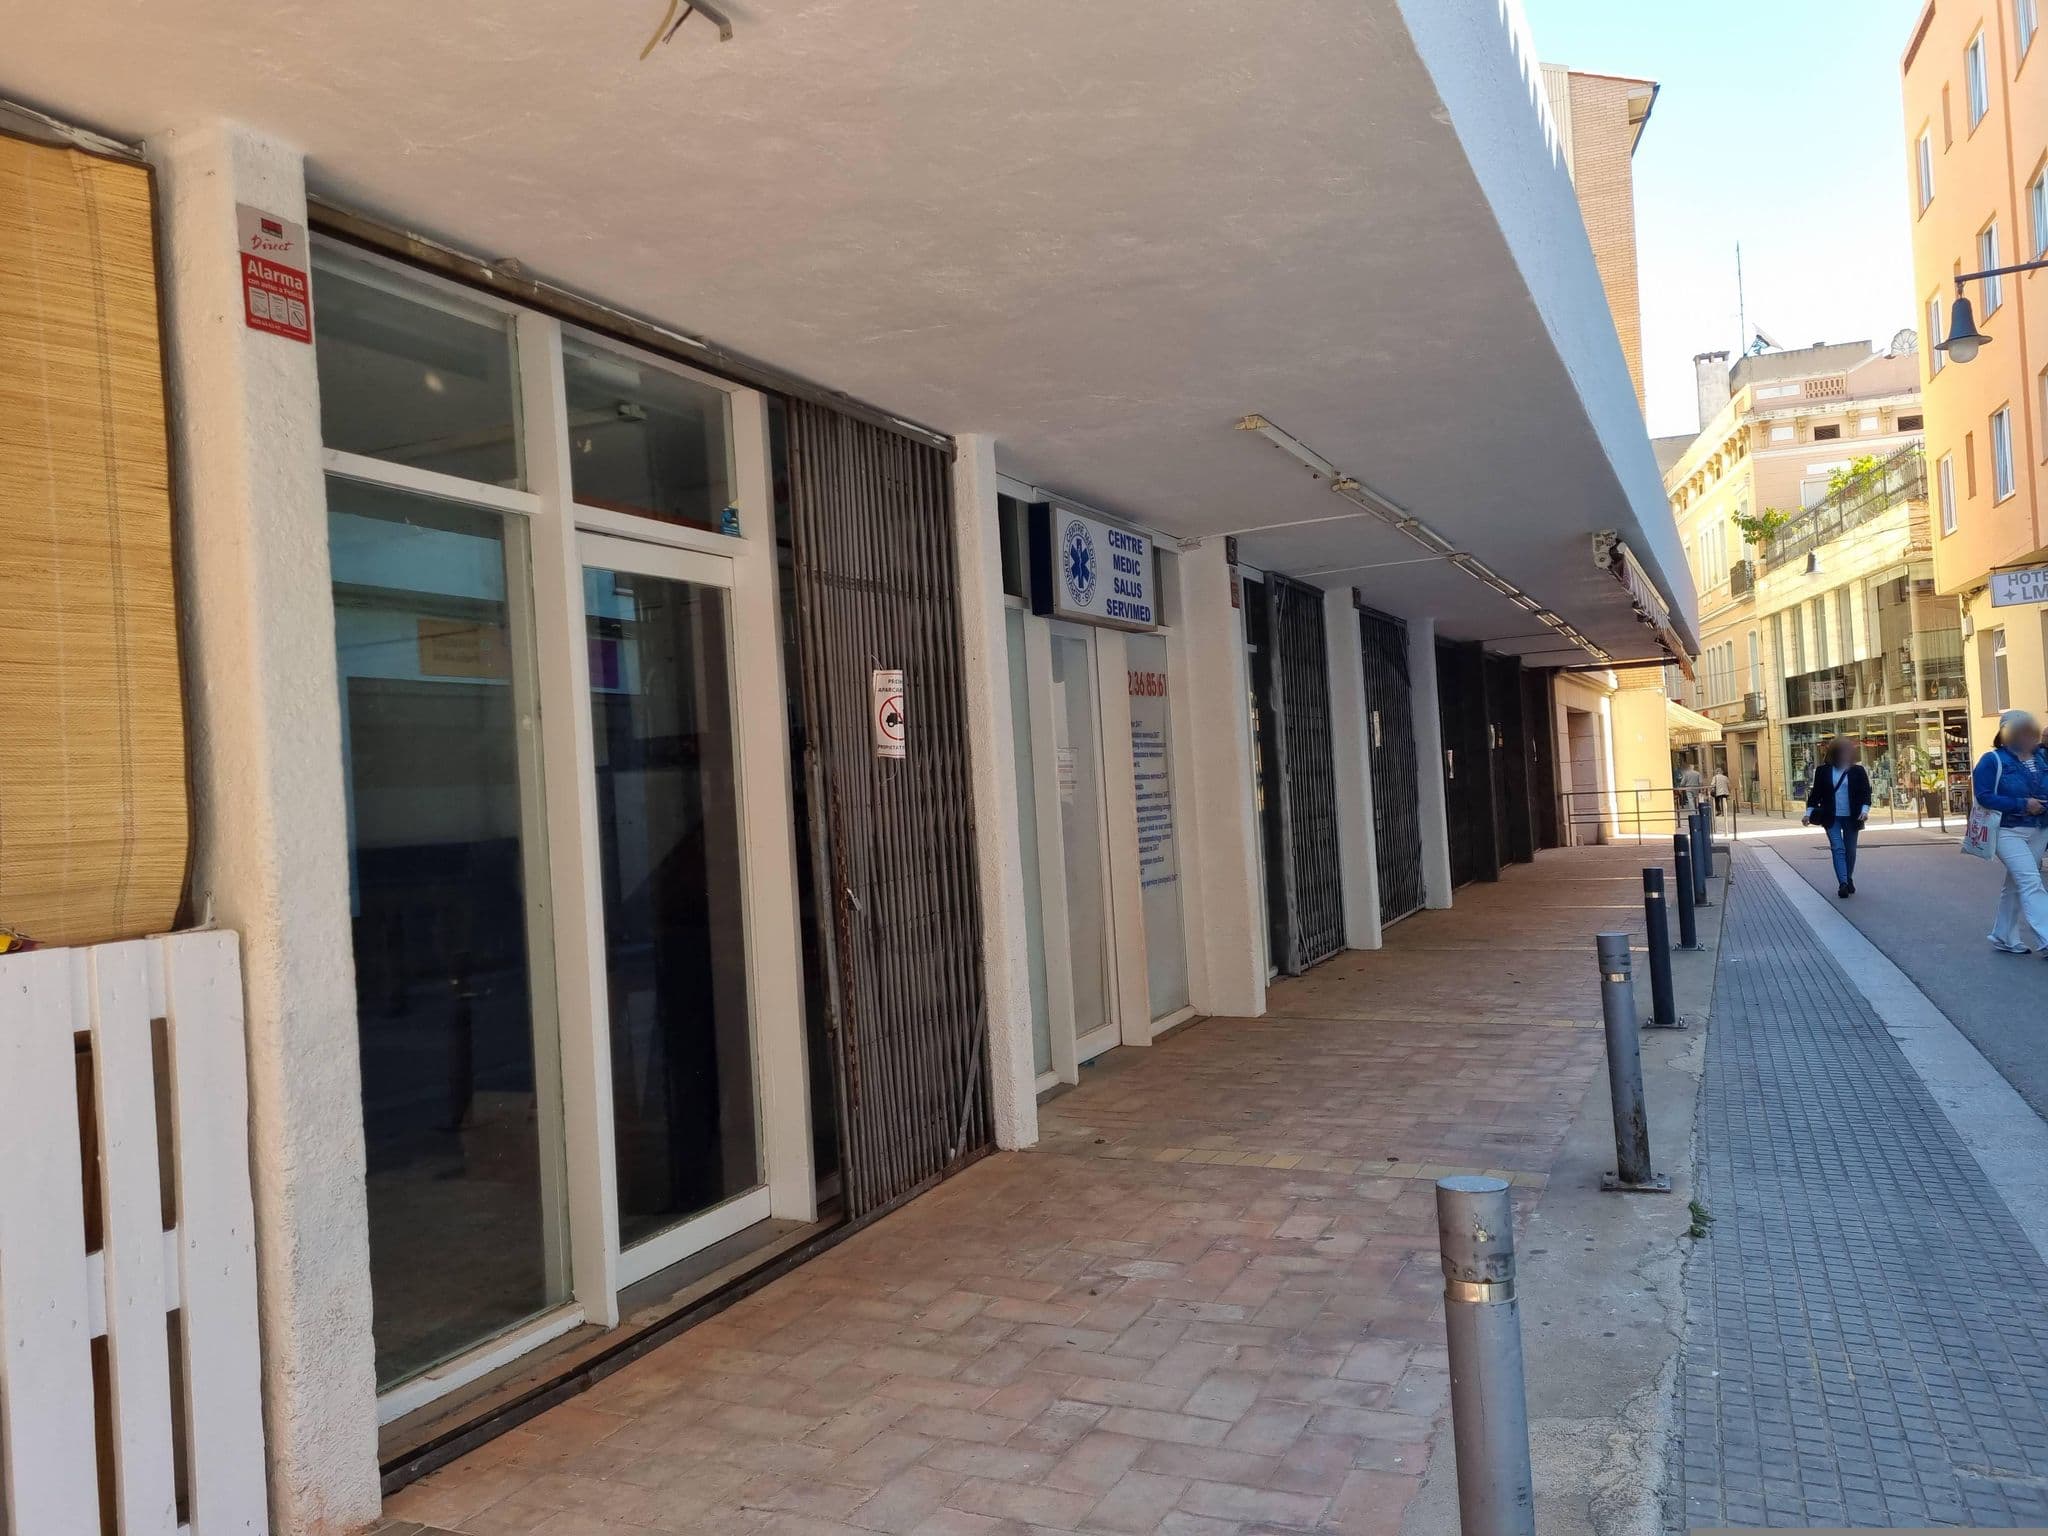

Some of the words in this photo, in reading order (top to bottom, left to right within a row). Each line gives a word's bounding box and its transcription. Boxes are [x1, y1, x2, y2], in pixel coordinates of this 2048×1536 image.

[248, 259, 304, 291] Alarma
[1108, 529, 1143, 555] CENTRE
[1113, 553, 1141, 576] MEDIC
[1114, 577, 1142, 599] SALUS
[1106, 598, 1151, 622] SERVIMED
